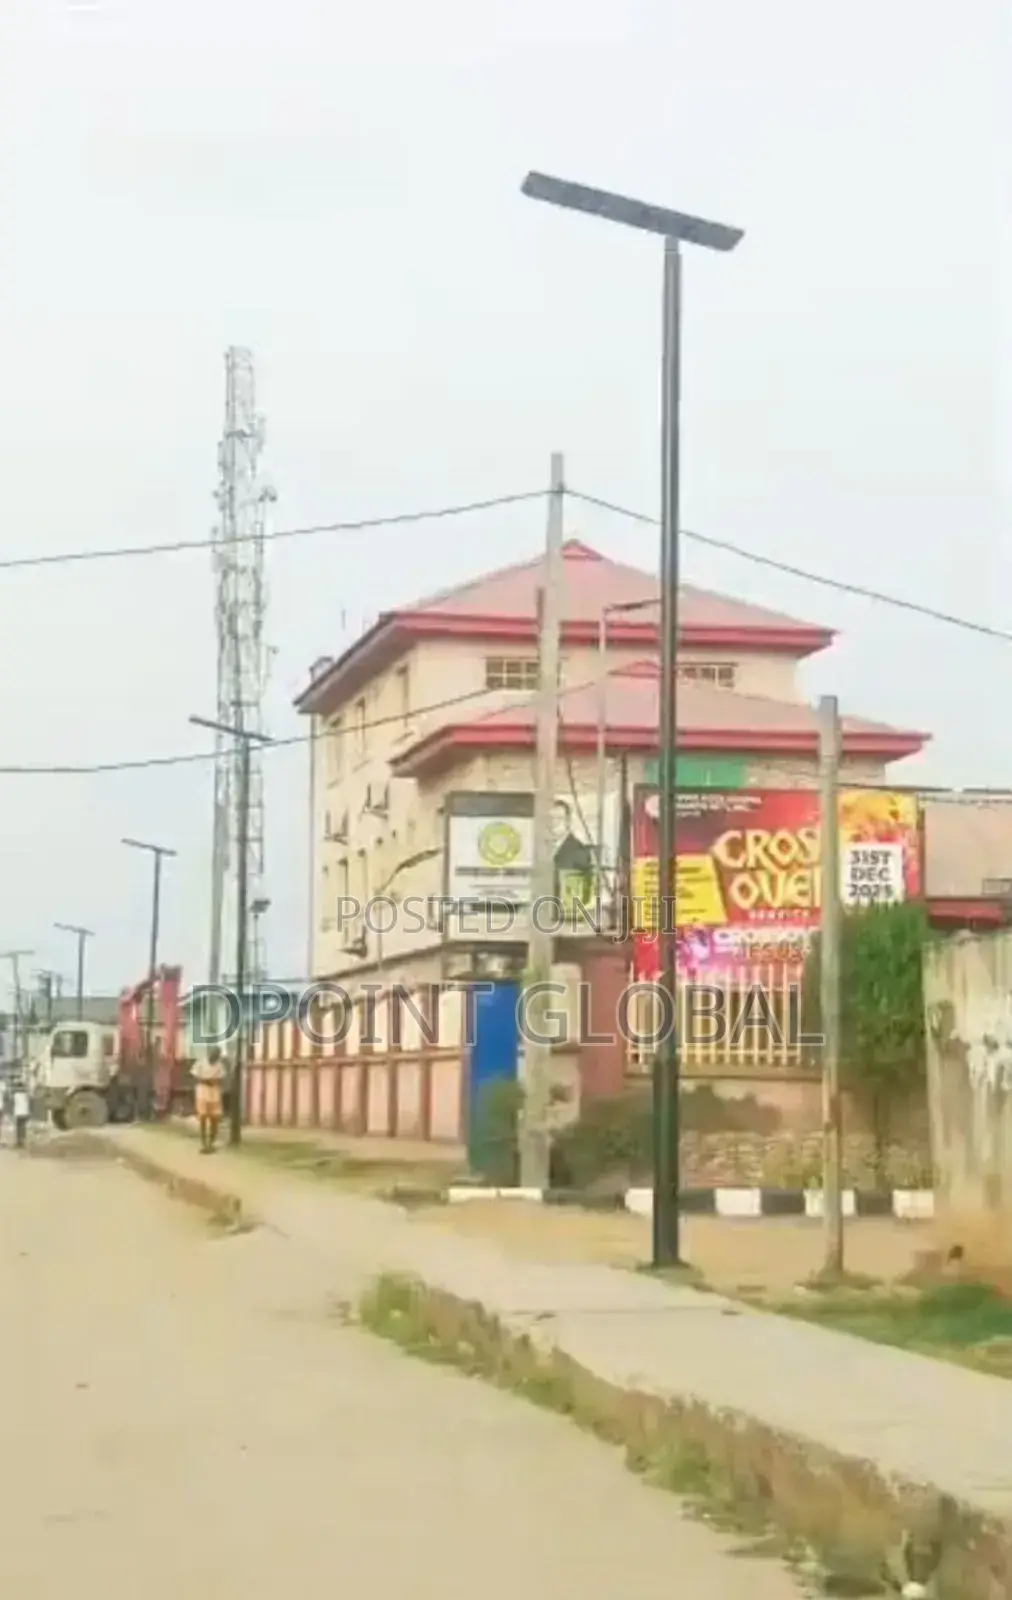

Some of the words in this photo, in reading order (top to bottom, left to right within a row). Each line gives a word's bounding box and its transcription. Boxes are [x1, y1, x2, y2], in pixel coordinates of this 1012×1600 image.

[712, 827, 821, 873] CROS
[850, 850, 892, 865] 31ST
[730, 868, 821, 909] OVE
[851, 867, 892, 882] DEC
